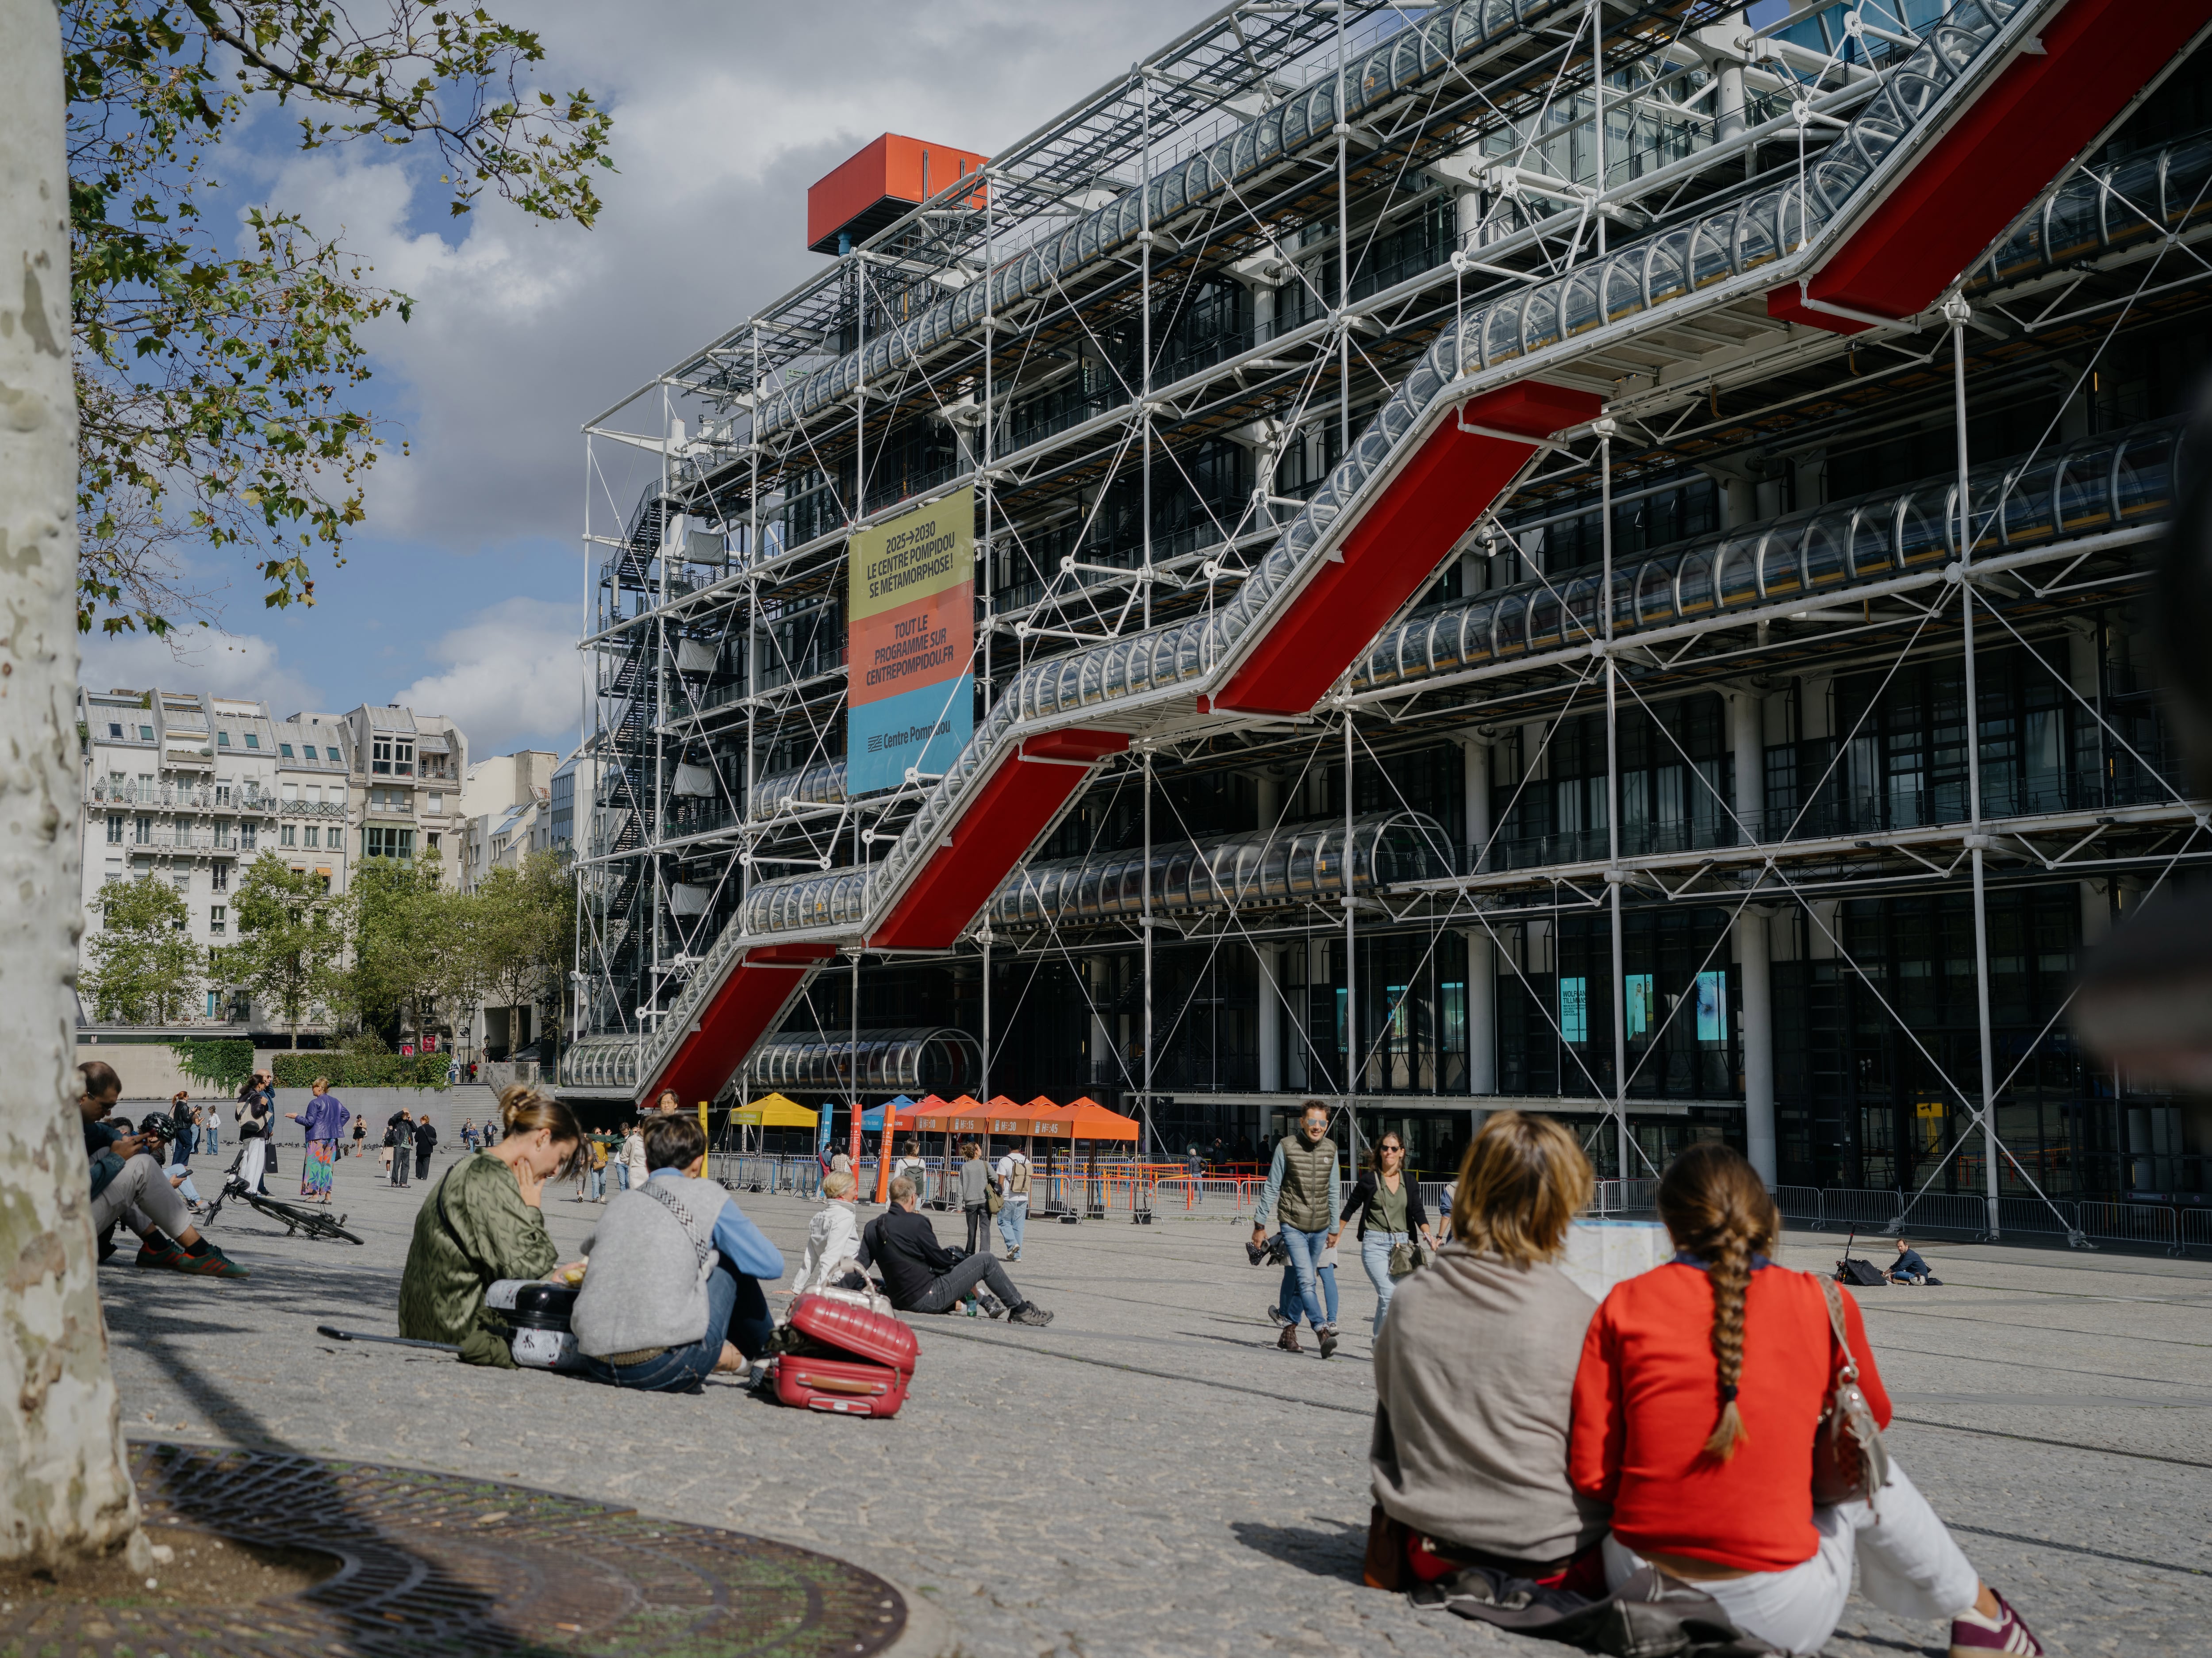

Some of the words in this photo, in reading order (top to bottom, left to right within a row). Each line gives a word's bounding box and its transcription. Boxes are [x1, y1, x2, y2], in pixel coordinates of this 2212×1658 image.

[868, 563, 876, 580] LE
[878, 551, 908, 576] CENTRE
[910, 531, 955, 564] POMPIDOU
[869, 581, 879, 599] SE
[895, 618, 916, 640] TOUT
[918, 614, 928, 633] LE
[875, 633, 929, 665] PROGRAMME
[930, 628, 946, 648] SUR
[867, 645, 953, 686] CENTREPOMPIDOU.FR
[884, 731, 908, 748] Centre
